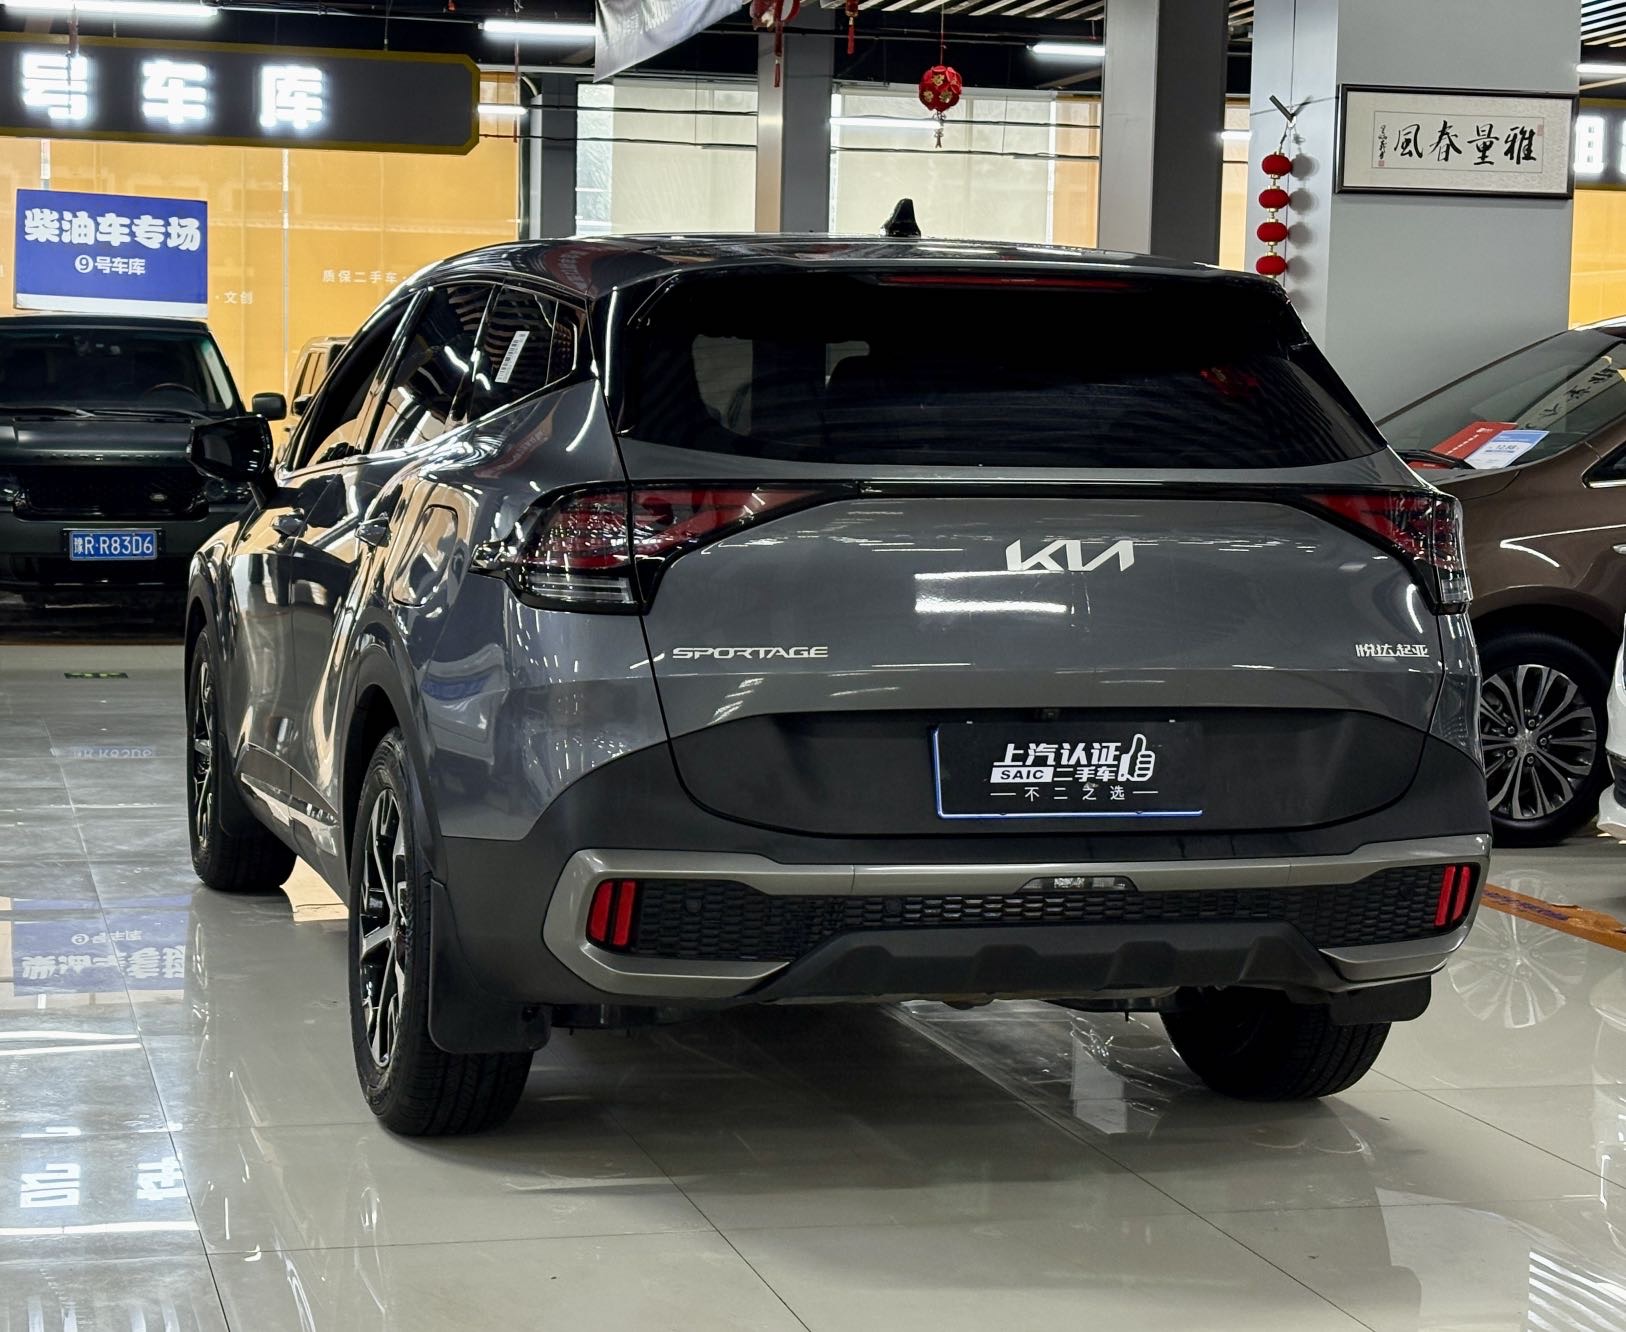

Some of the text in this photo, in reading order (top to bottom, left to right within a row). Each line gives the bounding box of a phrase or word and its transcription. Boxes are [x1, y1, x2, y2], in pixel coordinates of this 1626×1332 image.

[24, 208, 201, 251] 柴油车专场
[1005, 539, 1135, 572] KIA
[672, 646, 828, 659] SPORTAGE
[1355, 643, 1430, 657] 悦达起亚
[993, 743, 1122, 766] 上汽认证
[1000, 769, 1045, 780] SAIC
[1053, 767, 1117, 783] 二手车
[1023, 785, 1126, 802] 不二之选
